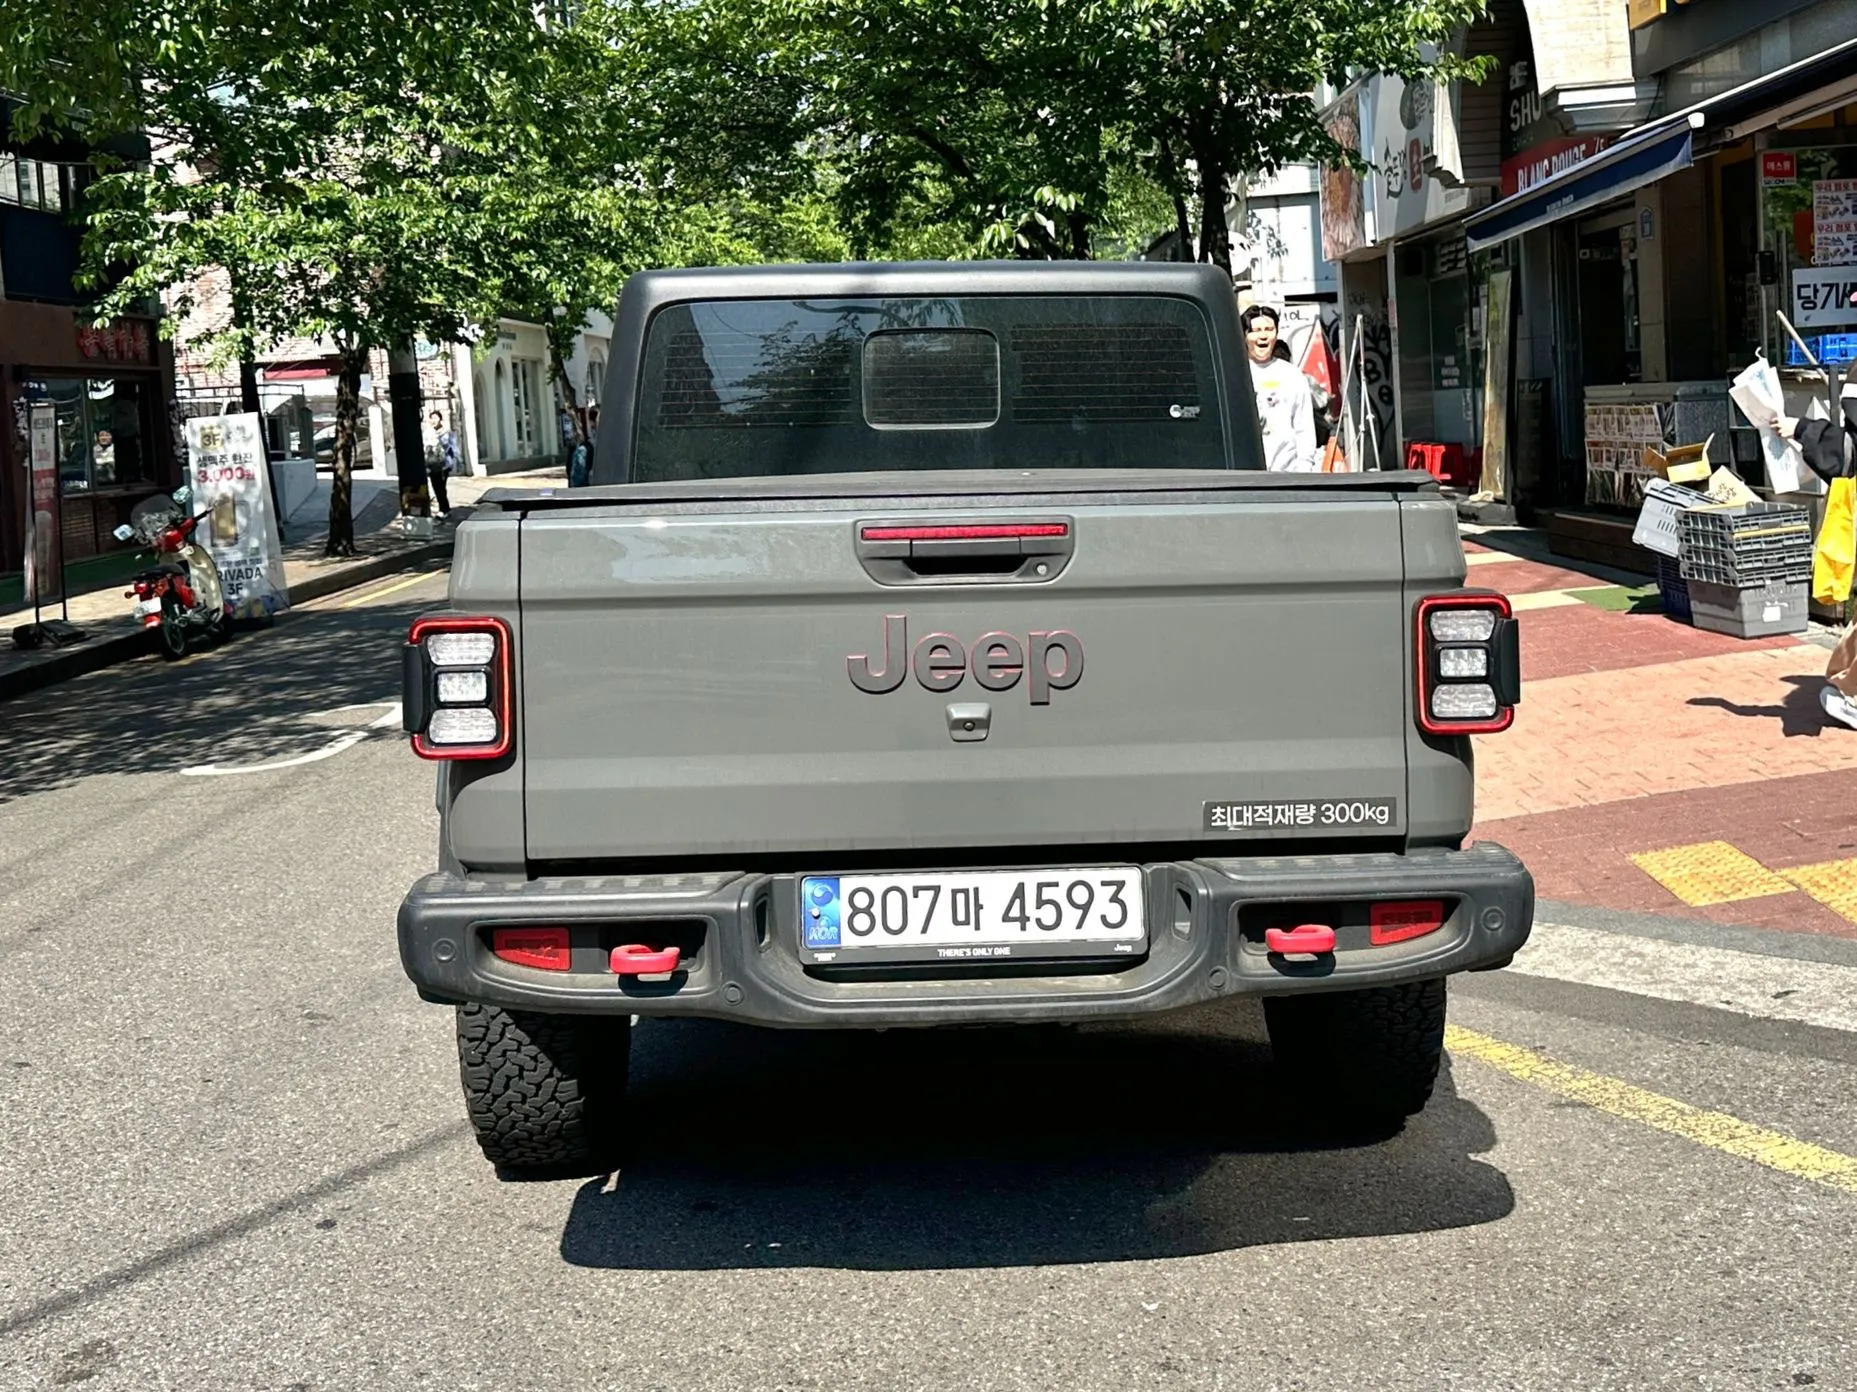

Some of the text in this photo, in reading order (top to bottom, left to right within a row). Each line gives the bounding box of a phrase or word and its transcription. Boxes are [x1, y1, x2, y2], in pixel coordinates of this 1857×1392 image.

[203, 433, 221, 447] 3F
[217, 567, 263, 582] RIVADA
[227, 583, 243, 595] 3F
[847, 614, 1084, 706] Jeep
[1211, 802, 1390, 827] 최대적재량 300kg
[847, 879, 1129, 937] 807마 4593
[937, 946, 1011, 958] THERE'S ONLY ONE
